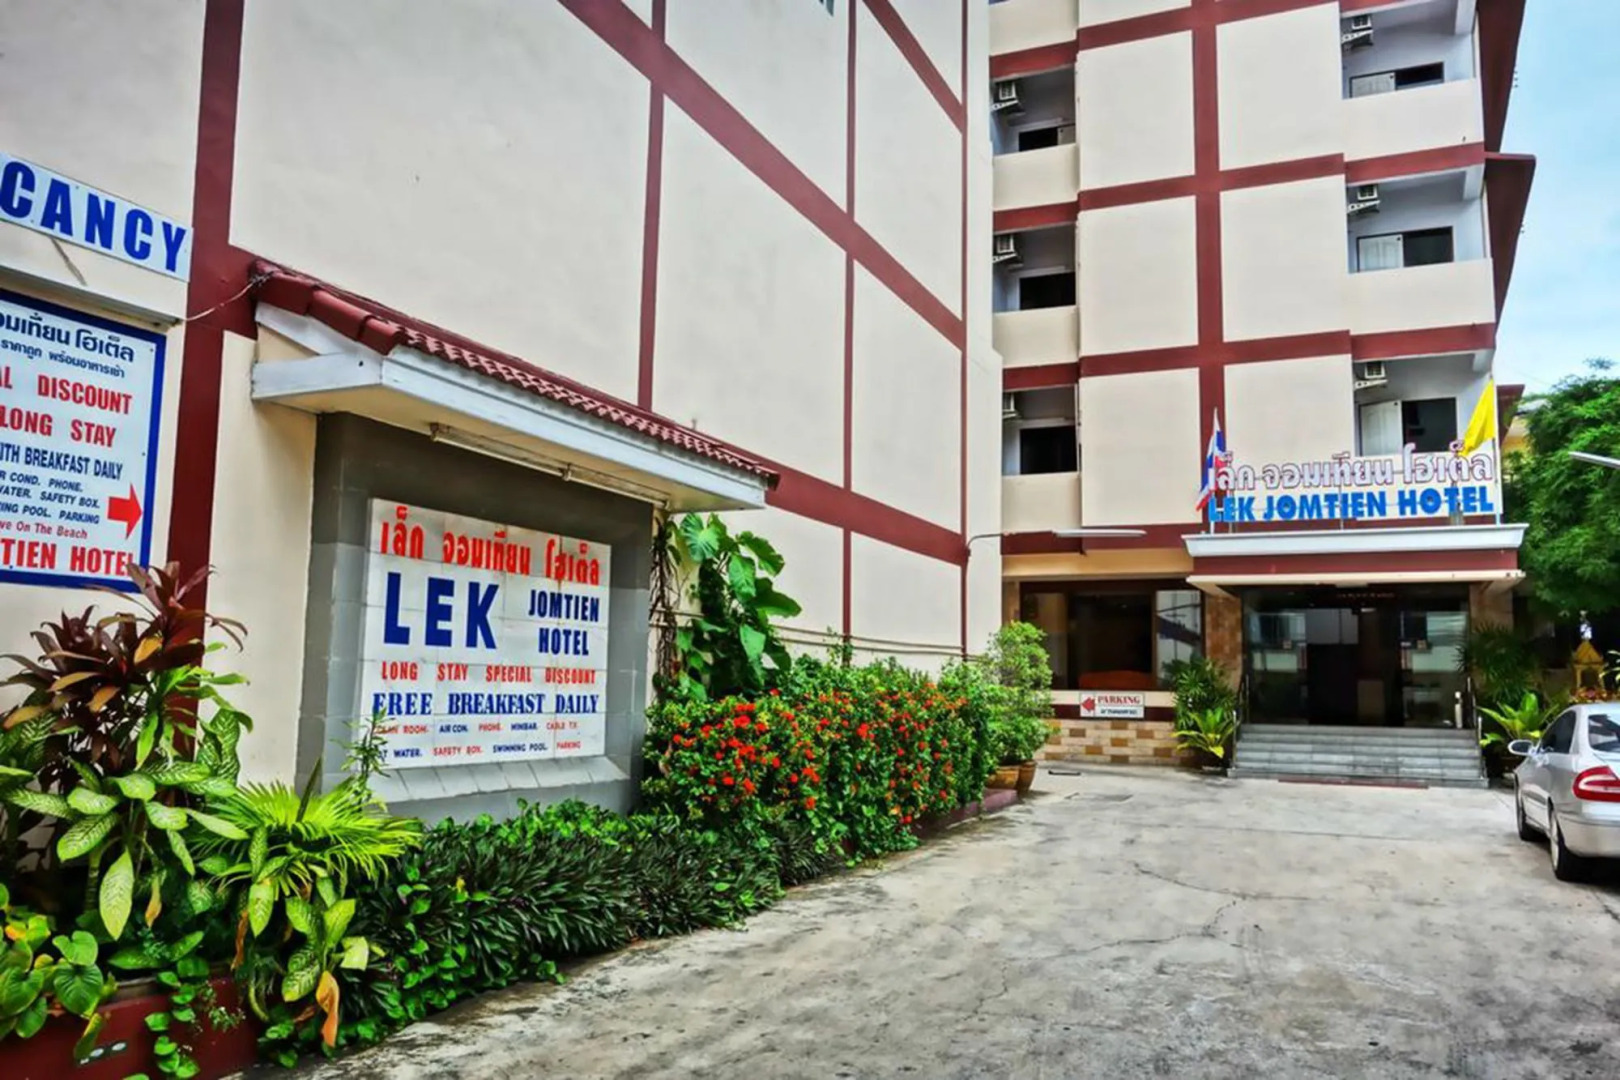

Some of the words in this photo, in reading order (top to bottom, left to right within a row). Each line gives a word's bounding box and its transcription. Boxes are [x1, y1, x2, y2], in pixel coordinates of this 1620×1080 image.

[0, 161, 187, 273] CANCY
[38, 374, 133, 415] DISCOUNT
[0, 404, 53, 436] LONG
[70, 419, 117, 448] STAY
[25, 446, 91, 475] BREAKFAST
[94, 459, 124, 481] DAILY
[10, 472, 41, 486] COND.
[48, 478, 84, 492] PHONE.
[22, 504, 52, 518] POOL.
[59, 510, 100, 525] PARKING
[40, 491, 77, 505] SAFETY
[79, 497, 100, 509] BOX.
[1208, 495, 1256, 522] LEK
[1263, 490, 1387, 521] JOMTIEN
[1397, 486, 1494, 516] HOTEL
[16, 520, 31, 532] On
[34, 522, 53, 535] The
[57, 525, 88, 540] Beach
[380, 505, 425, 560] เล็ก
[1, 537, 57, 570] TIEN
[383, 571, 500, 649] LEK
[528, 589, 600, 622] JOMTIEN
[538, 627, 589, 656] HOTEL
[381, 661, 418, 681] LONG
[437, 663, 469, 682] STAY
[485, 664, 533, 683] SPECIAL
[545, 667, 596, 685] DISCOUNT
[373, 692, 433, 716] FREE
[448, 693, 546, 715] BREAKFAST
[555, 693, 599, 714] DAILY
[1097, 695, 1140, 704] PARKING
